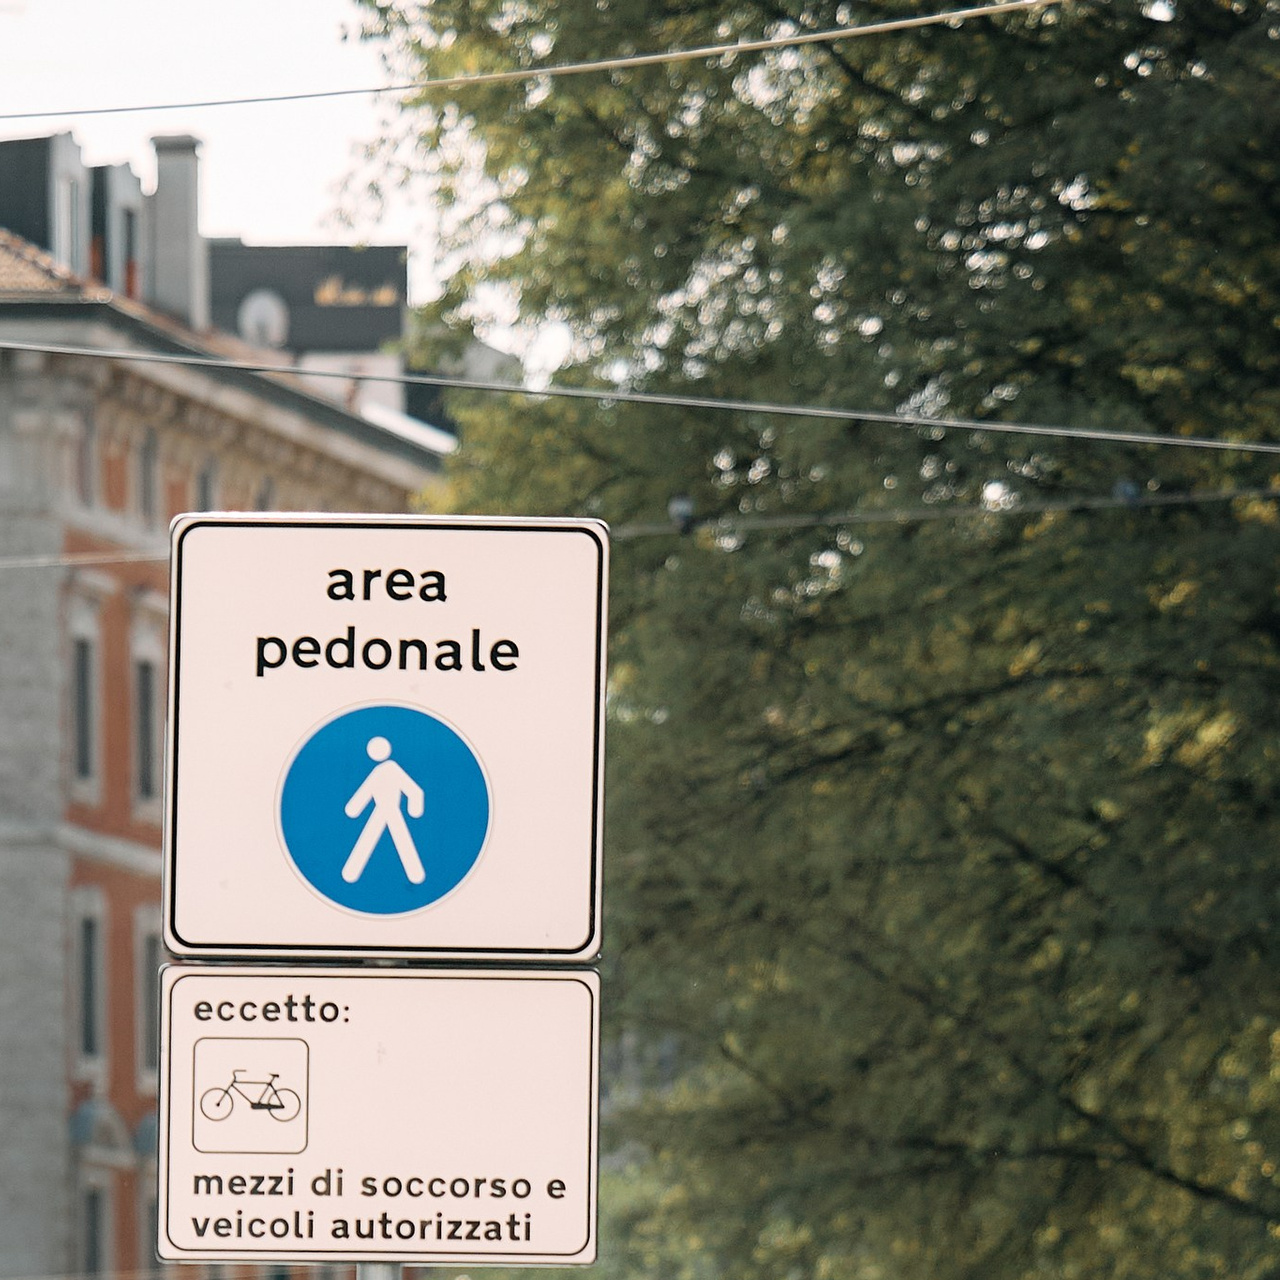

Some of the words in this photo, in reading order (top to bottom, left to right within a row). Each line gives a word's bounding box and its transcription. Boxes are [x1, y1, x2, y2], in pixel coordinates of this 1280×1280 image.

[326, 568, 448, 603] area
[256, 625, 520, 678] pedonale
[193, 994, 350, 1023] eccetto:
[193, 1167, 294, 1196] mezzi
[311, 1168, 344, 1197] di
[360, 1176, 532, 1199] soccorso
[546, 1178, 567, 1200] e
[191, 1209, 315, 1239] veicoli
[330, 1211, 532, 1242] autorizzati
